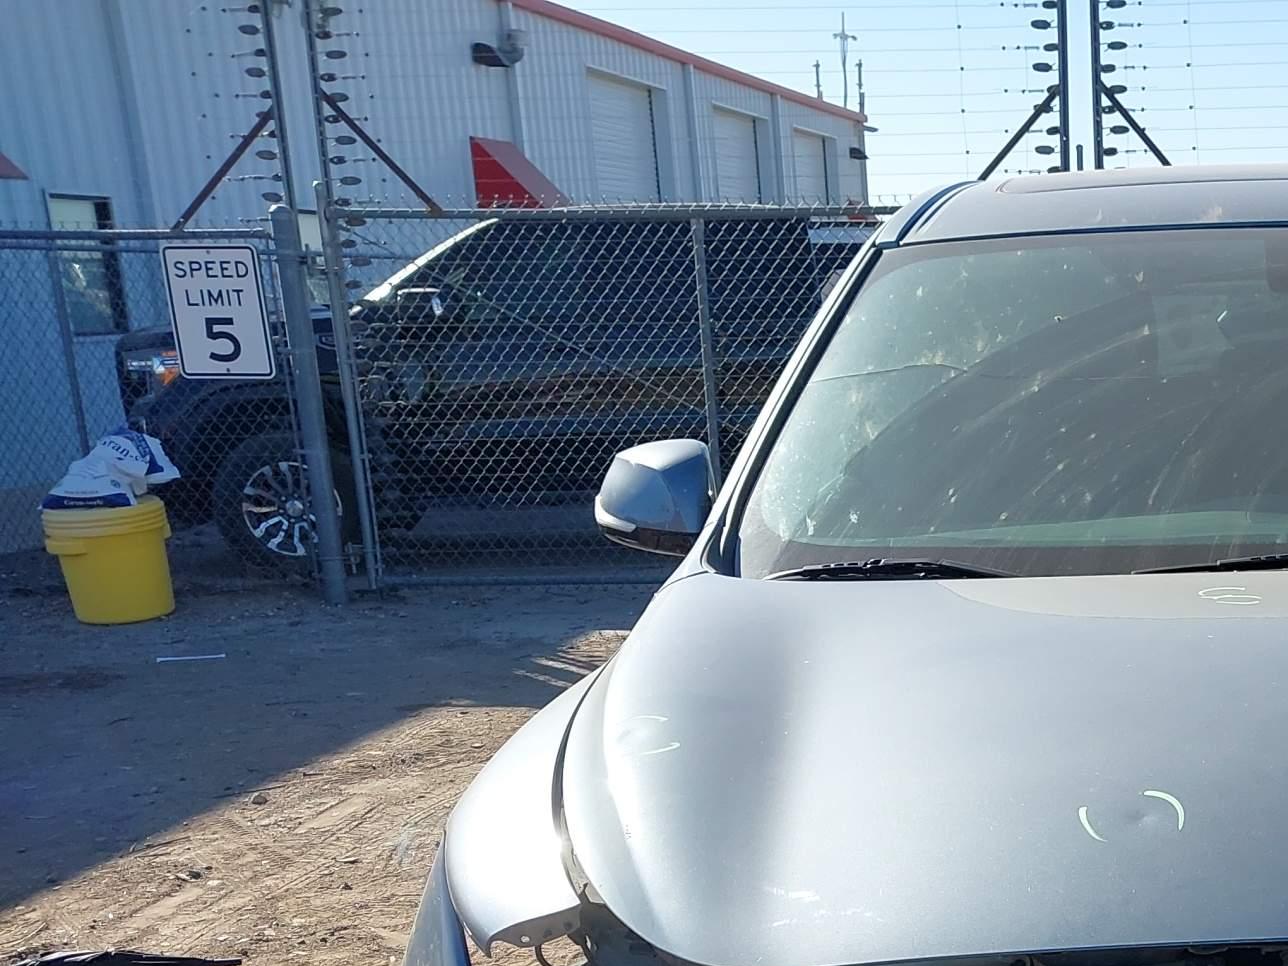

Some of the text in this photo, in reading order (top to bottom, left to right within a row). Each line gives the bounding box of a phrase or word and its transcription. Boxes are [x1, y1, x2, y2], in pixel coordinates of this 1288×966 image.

[173, 260, 249, 279] SPEED
[185, 289, 244, 307] LIMIT
[205, 317, 242, 363] 5
